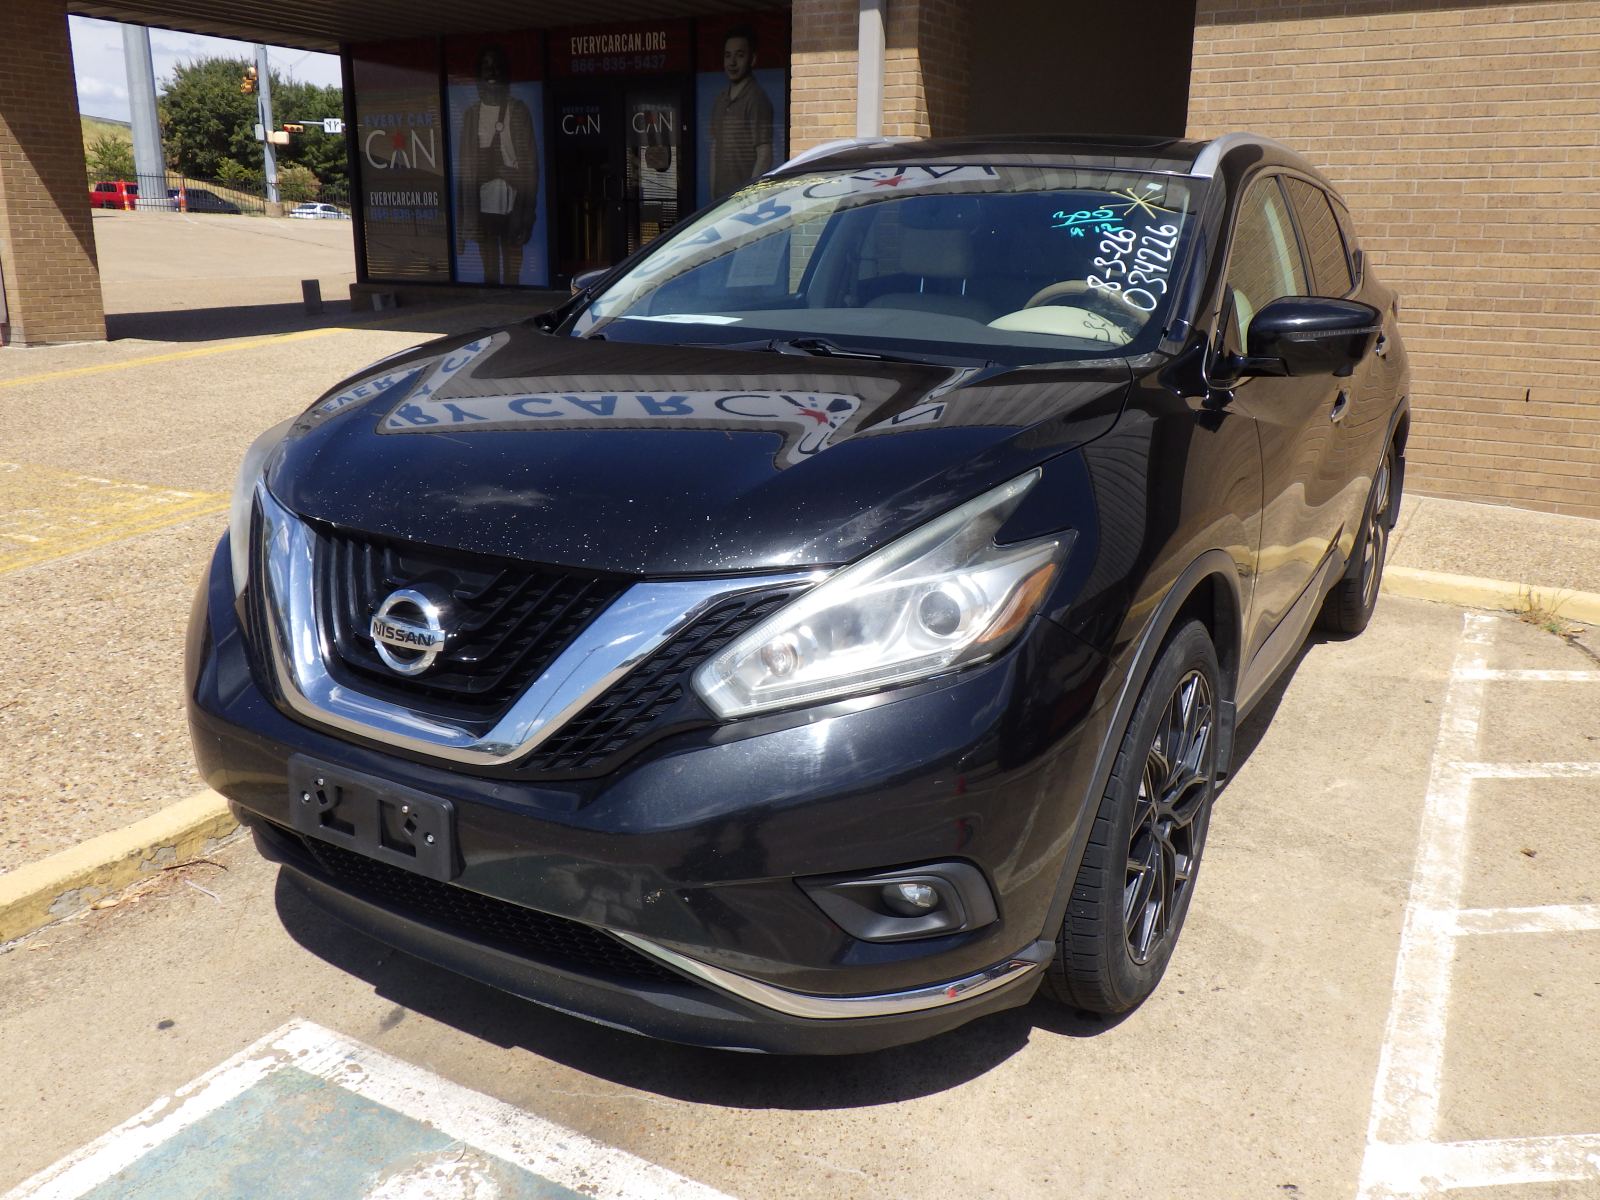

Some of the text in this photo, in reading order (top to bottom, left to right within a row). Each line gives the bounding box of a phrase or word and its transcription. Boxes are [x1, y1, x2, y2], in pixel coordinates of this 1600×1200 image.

[570, 31, 667, 55] EVERYCARCAN.ORG
[363, 113, 433, 128] EVERY CAR
[562, 113, 601, 135] CAN
[632, 111, 673, 134] CAN
[365, 129, 436, 169] CAN
[370, 191, 438, 206] EVERYCARCAN.ORG
[1122, 224, 1178, 311] 034226
[373, 621, 431, 647] NISSAN
